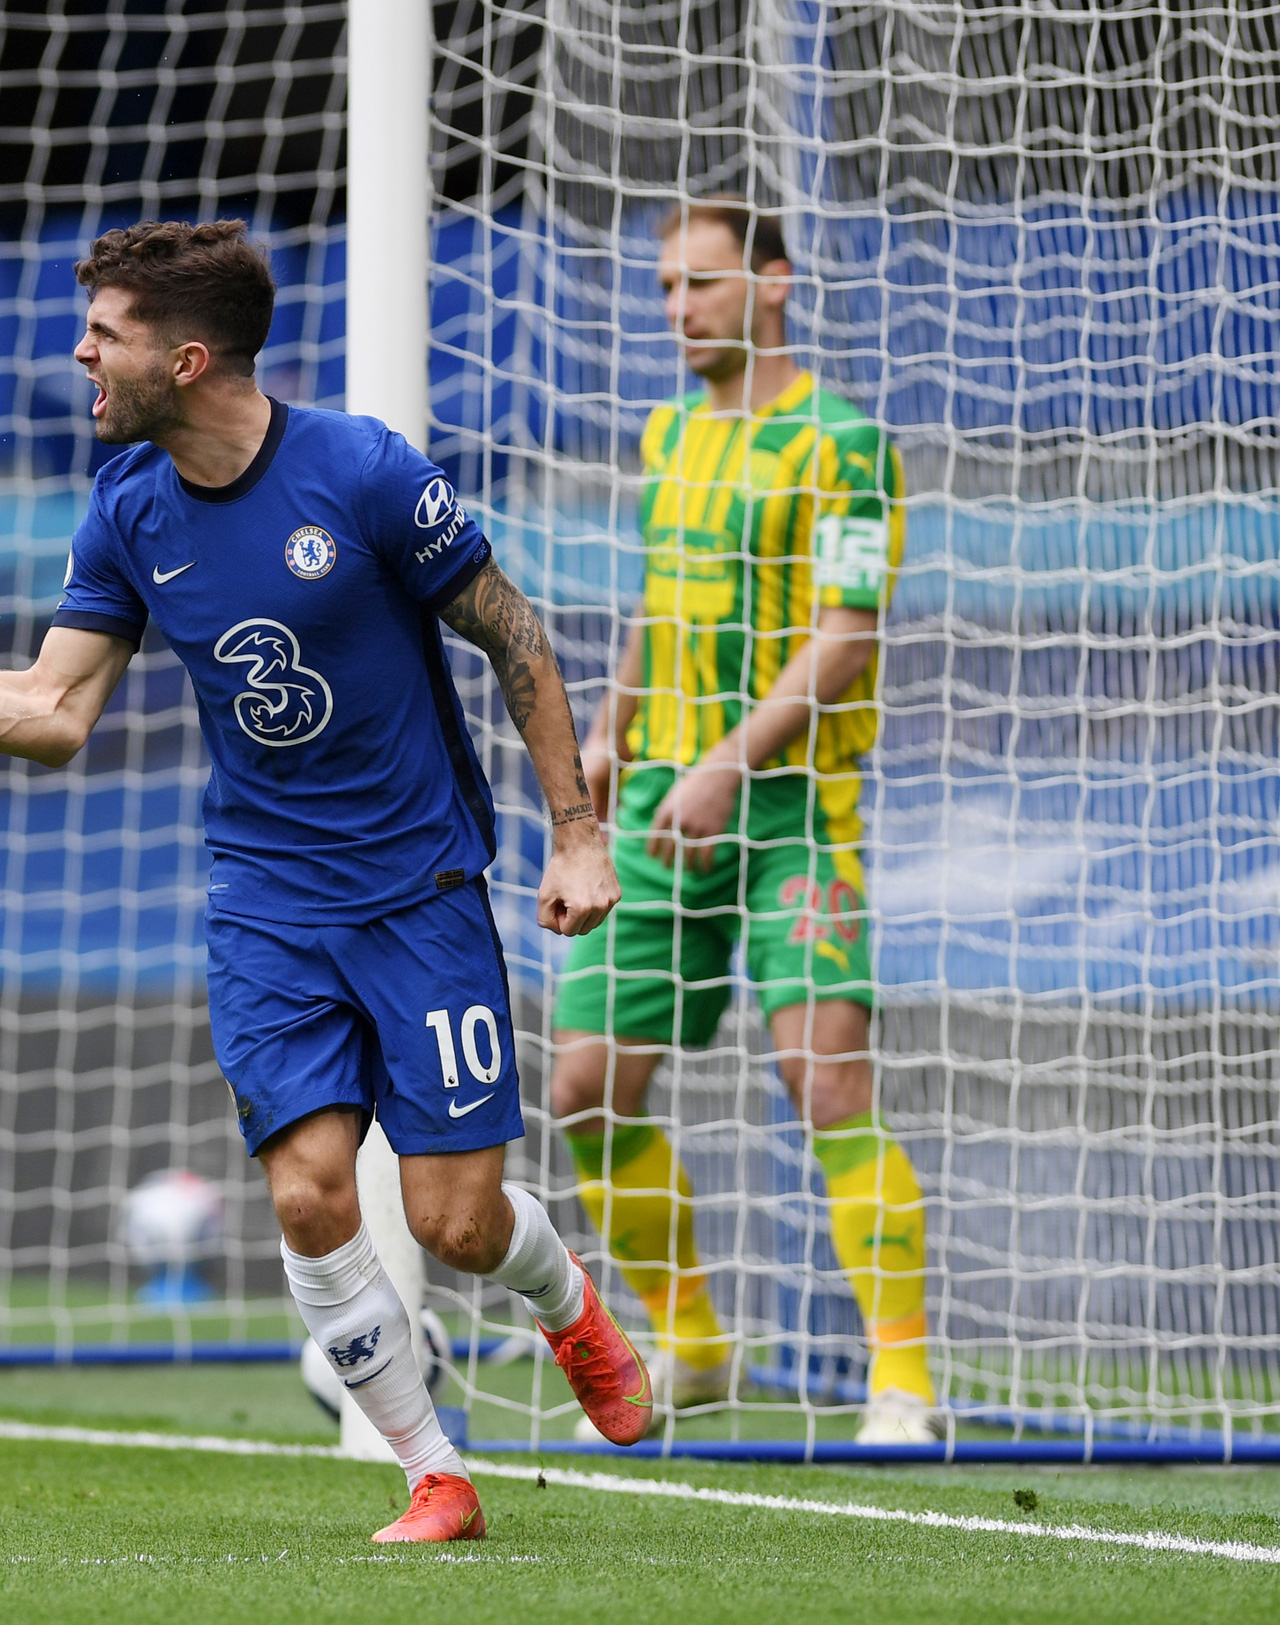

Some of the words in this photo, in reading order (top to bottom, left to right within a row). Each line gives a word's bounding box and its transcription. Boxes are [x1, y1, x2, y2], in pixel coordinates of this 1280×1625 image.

[291, 528, 323, 543] CHELSEA
[817, 514, 886, 566] 12
[213, 617, 334, 747] 3
[777, 874, 860, 946] 20
[425, 1004, 502, 1089] 10
